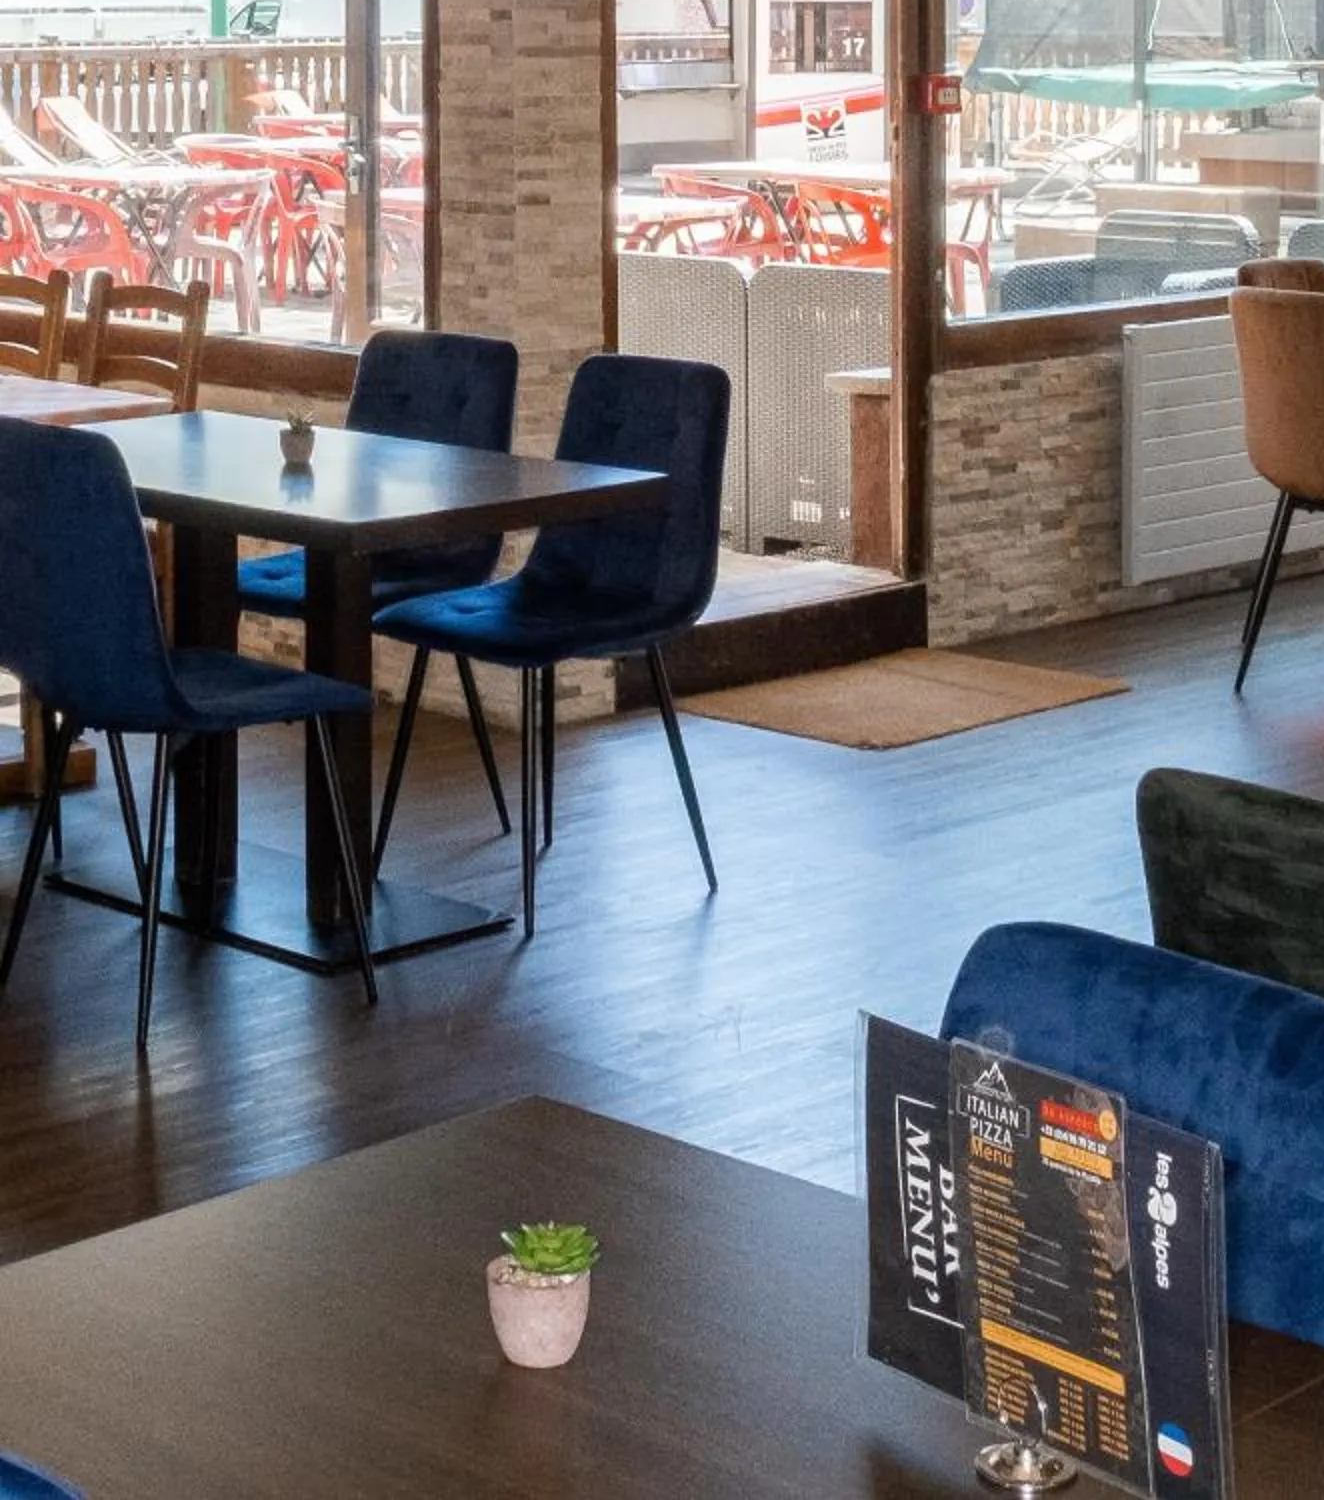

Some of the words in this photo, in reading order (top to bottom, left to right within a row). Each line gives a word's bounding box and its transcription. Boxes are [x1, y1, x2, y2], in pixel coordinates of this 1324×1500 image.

[842, 37, 866, 58] 17
[966, 1094, 1020, 1130] ITALIAN
[969, 1115, 1013, 1152] PIZZA
[970, 1135, 1013, 1169] Menu
